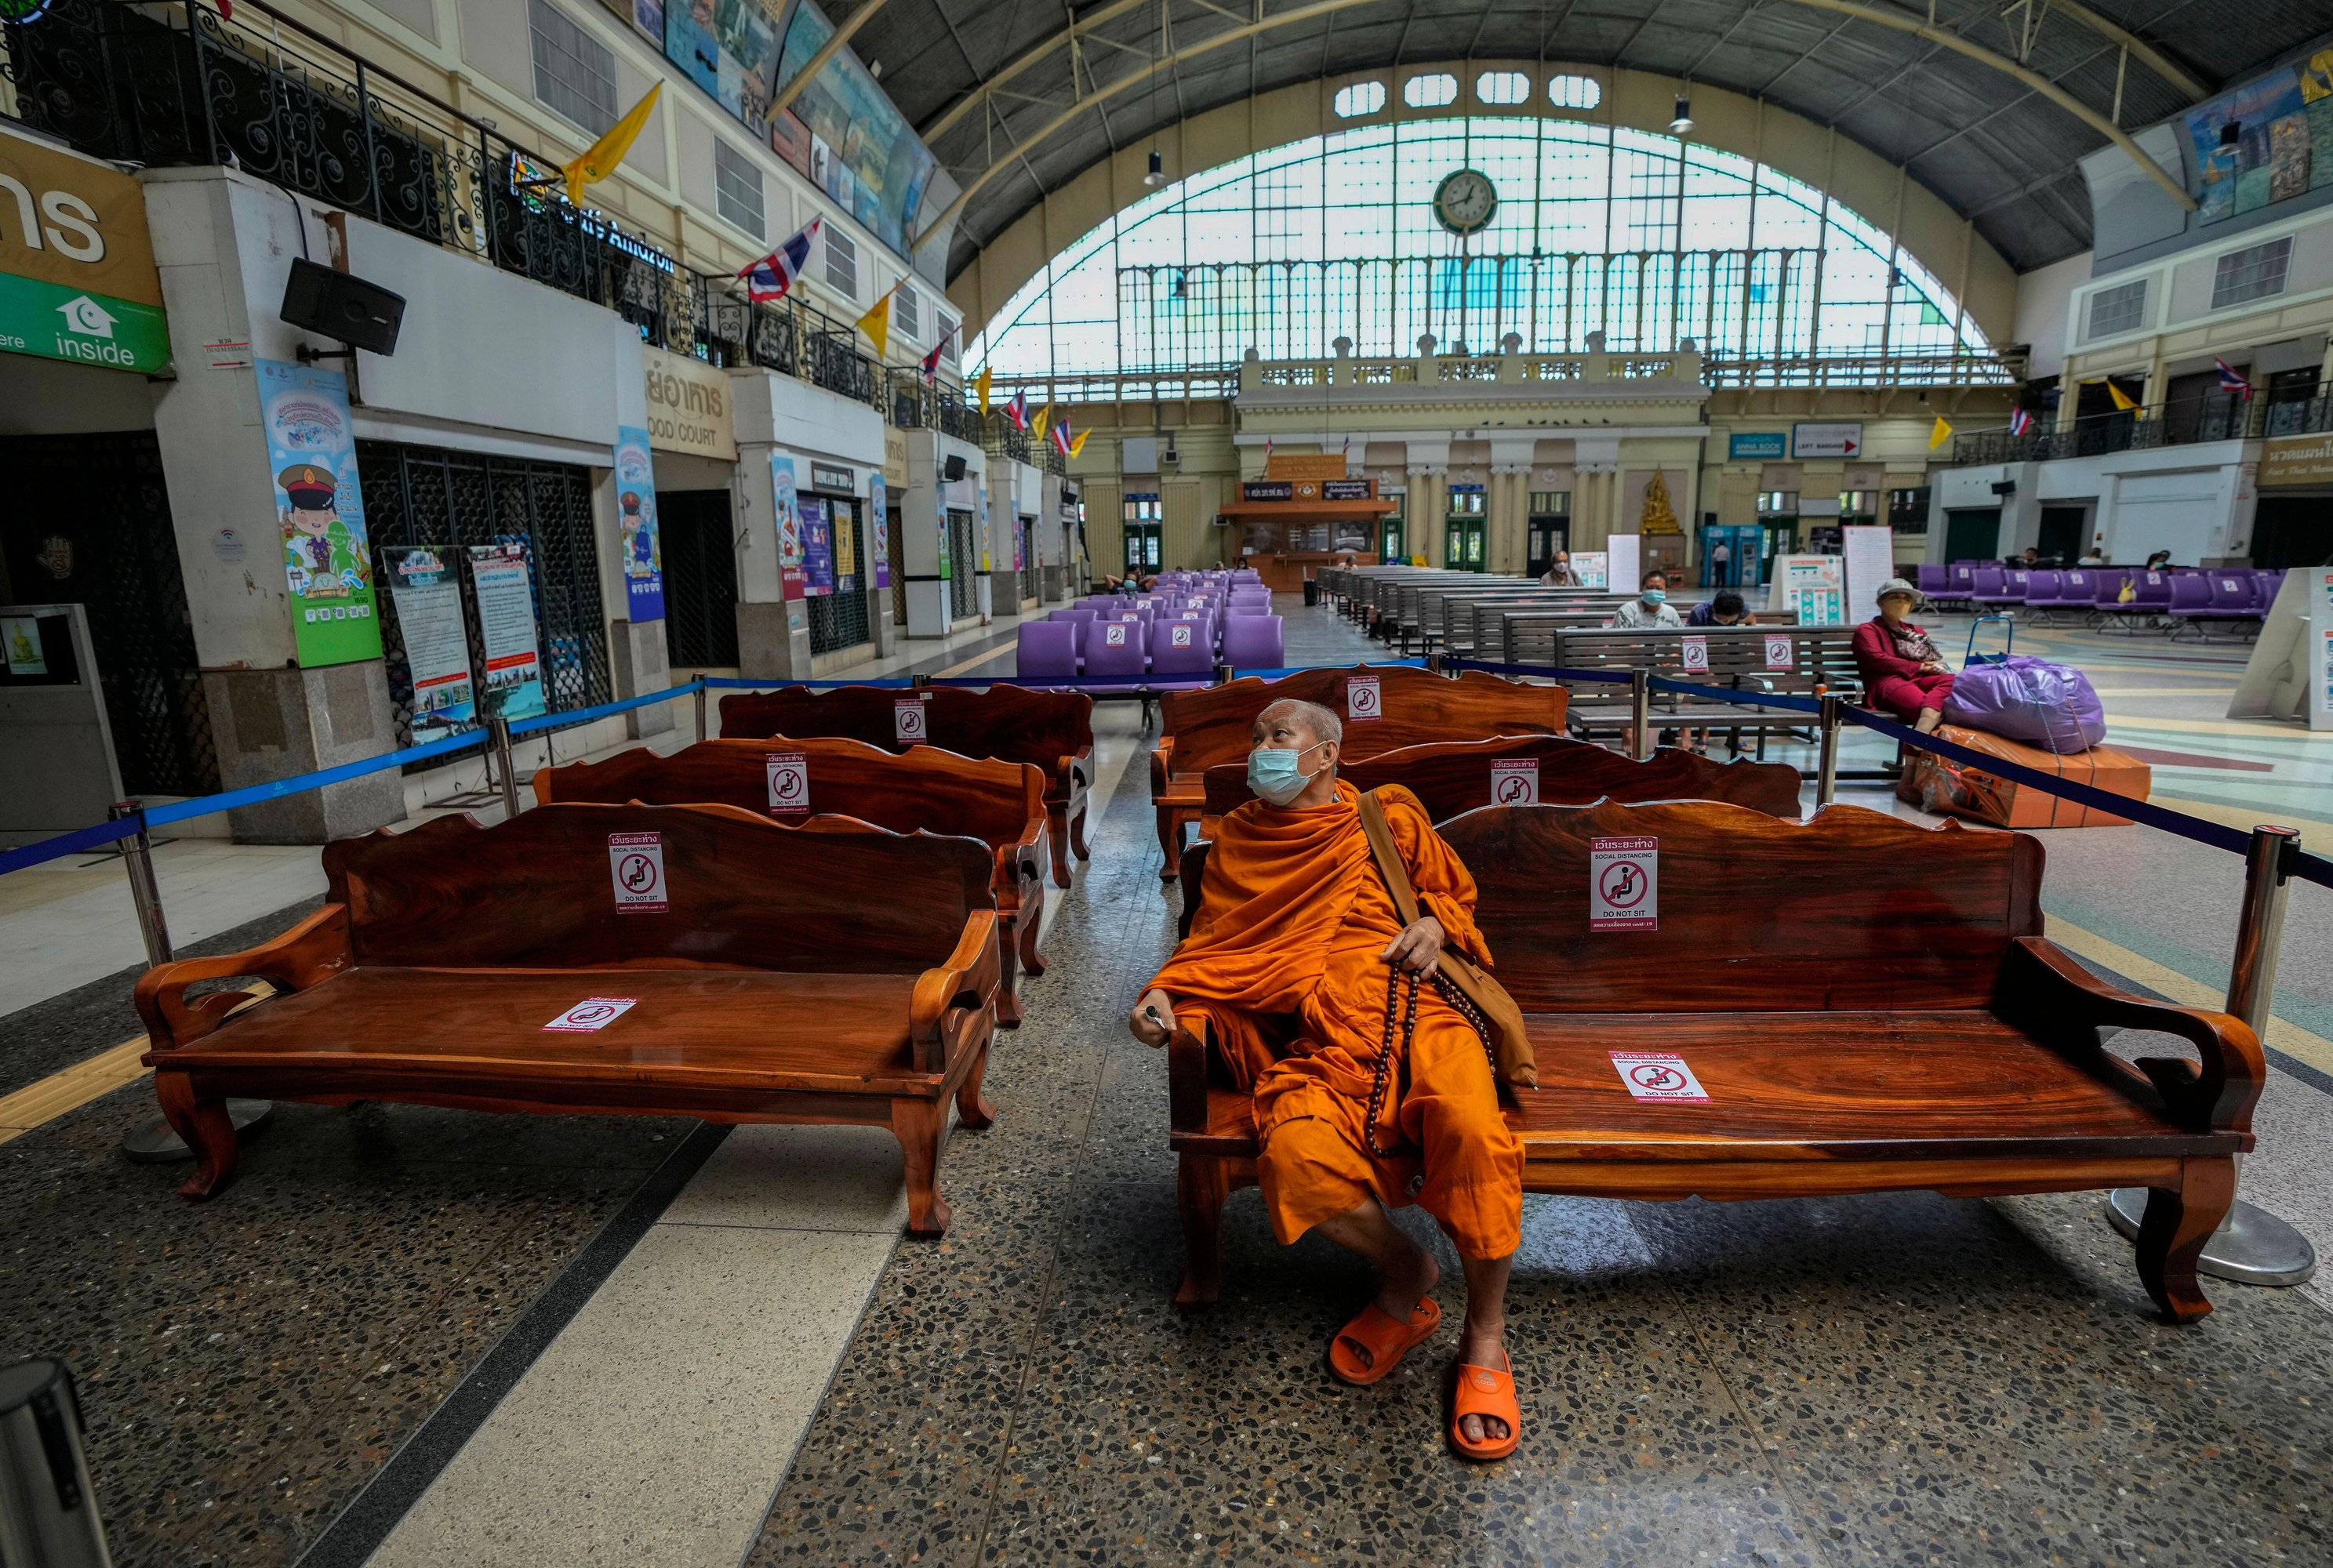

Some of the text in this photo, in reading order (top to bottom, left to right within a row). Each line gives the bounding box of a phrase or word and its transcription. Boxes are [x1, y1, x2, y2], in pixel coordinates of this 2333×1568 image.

[56, 332, 135, 365] inside
[646, 360, 723, 417] ย์อาหาร
[647, 416, 716, 446] OOD COURT
[612, 834, 657, 844] เว้นระยะห่าง
[1595, 839, 1653, 849] เว้นระยะห่าง
